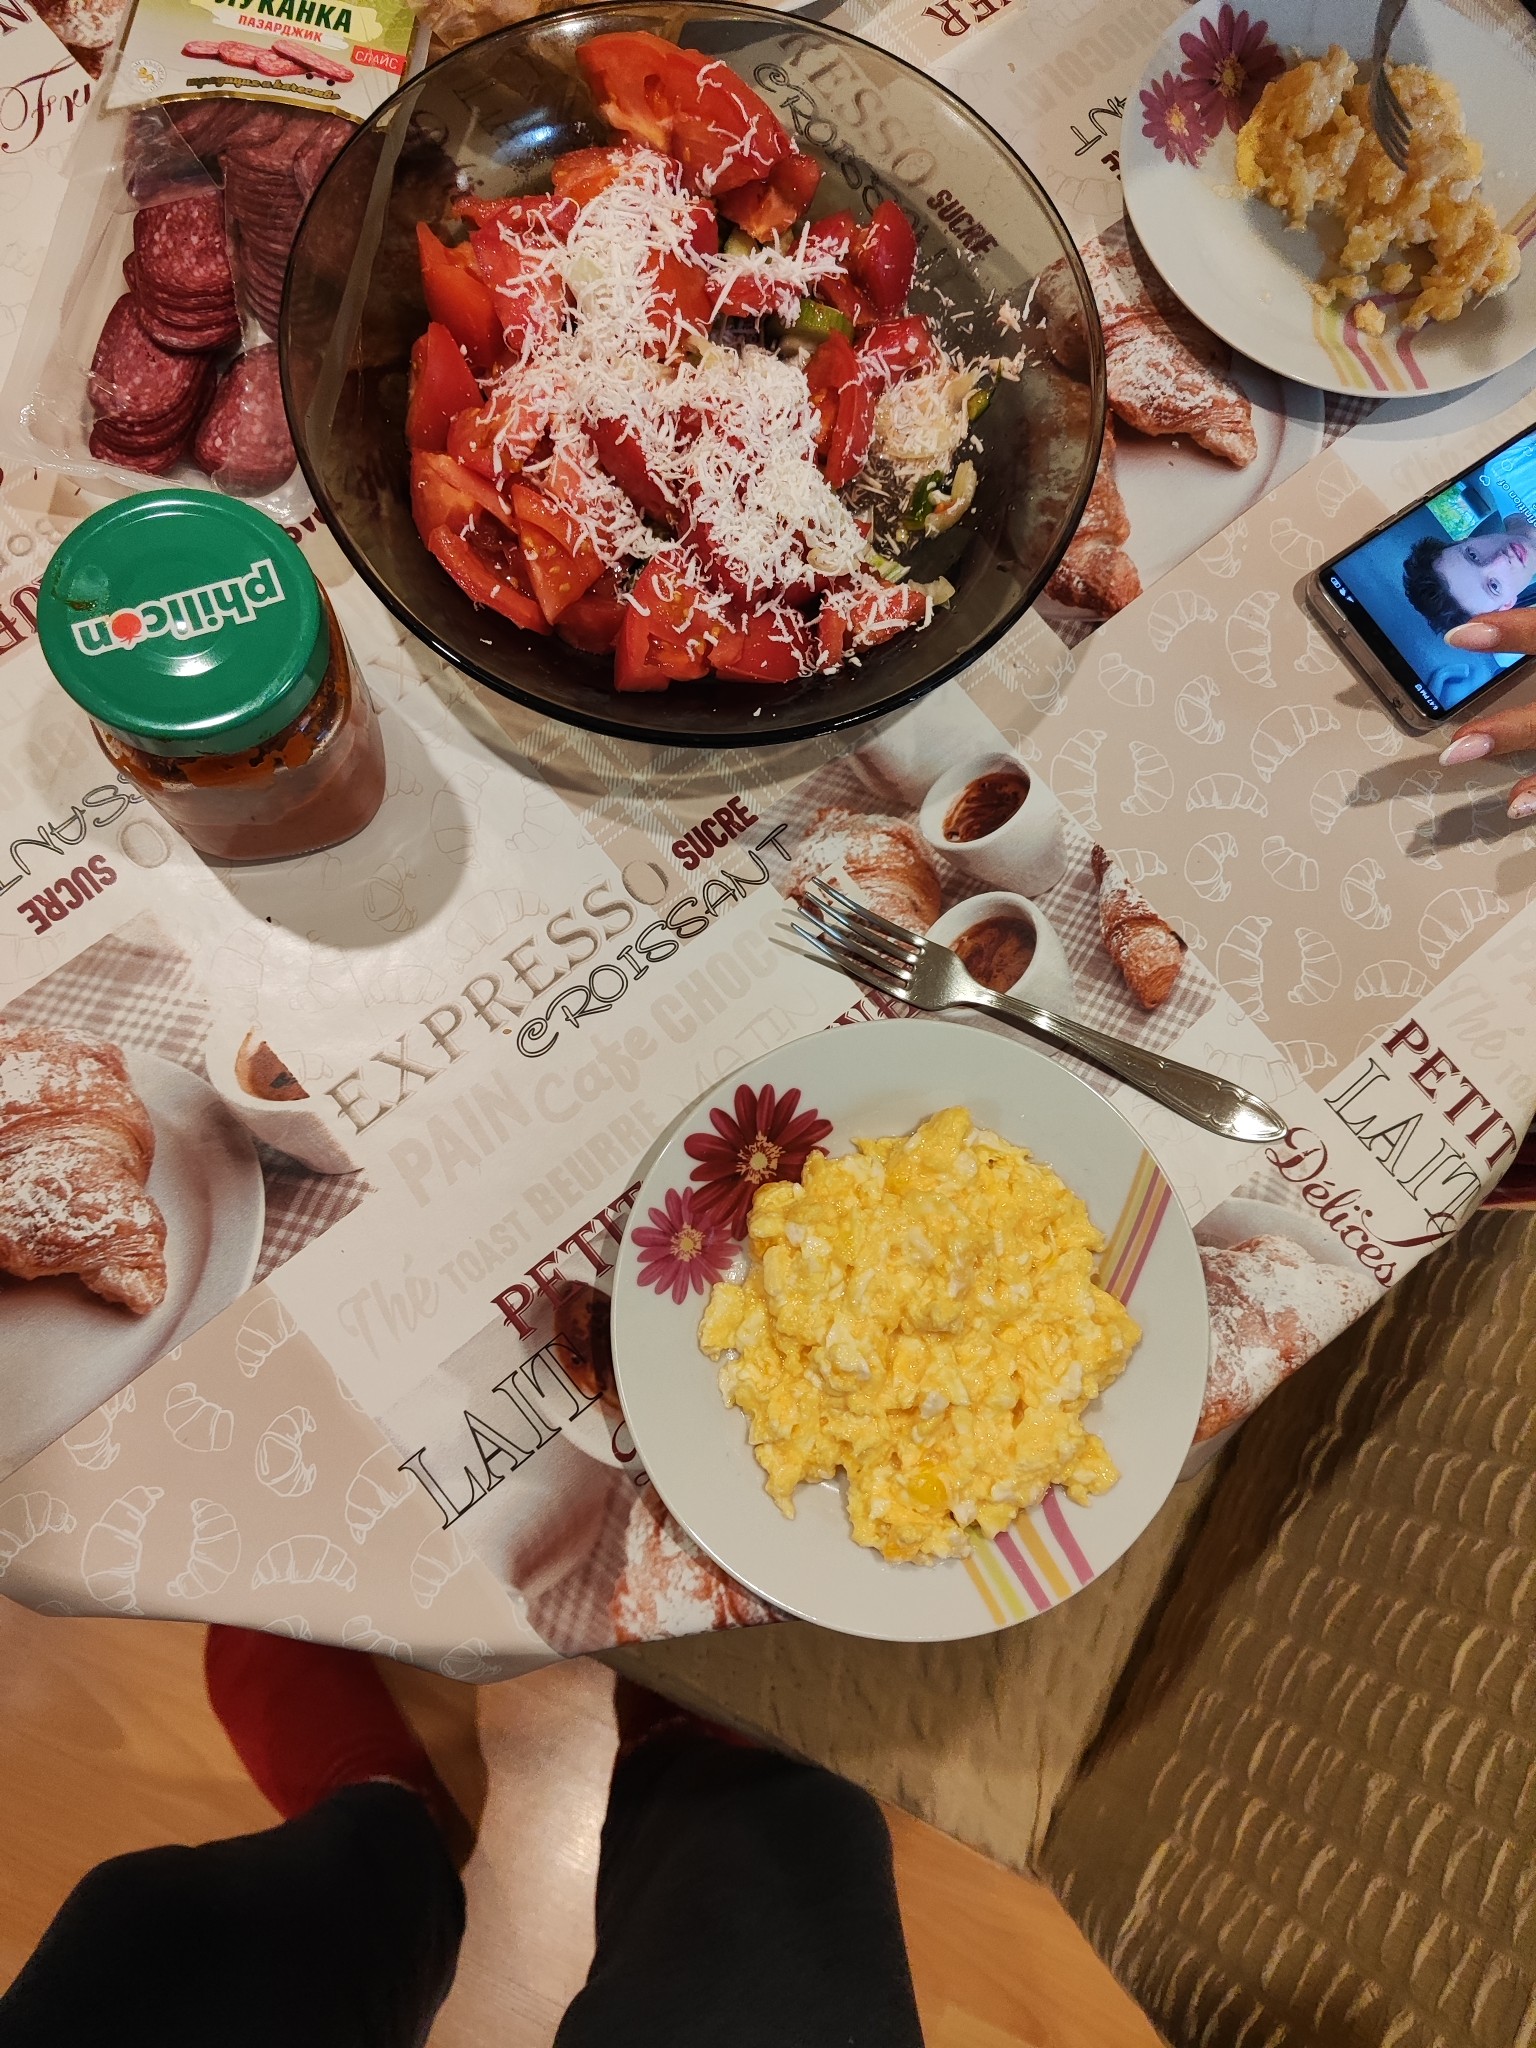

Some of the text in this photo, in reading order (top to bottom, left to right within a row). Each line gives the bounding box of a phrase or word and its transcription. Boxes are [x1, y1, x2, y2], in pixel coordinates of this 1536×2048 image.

[238, 14, 324, 42] ПАЗАРДЖИК
[354, 49, 399, 70] СЛАЙС
[71, 559, 285, 656] philicon
[17, 855, 117, 935] SUCRE
[671, 795, 759, 871] SUCRE
[323, 859, 671, 1137] EXPRESSO
[516, 823, 796, 1058] CROISSANT
[387, 1070, 534, 1208] PAIN
[1382, 1018, 1518, 1171] PETIT
[439, 1209, 533, 1296] TOAST
[521, 1100, 667, 1227] BEURRE
[1265, 1126, 1397, 1289] Délices
[397, 1333, 603, 1530] LAIT
